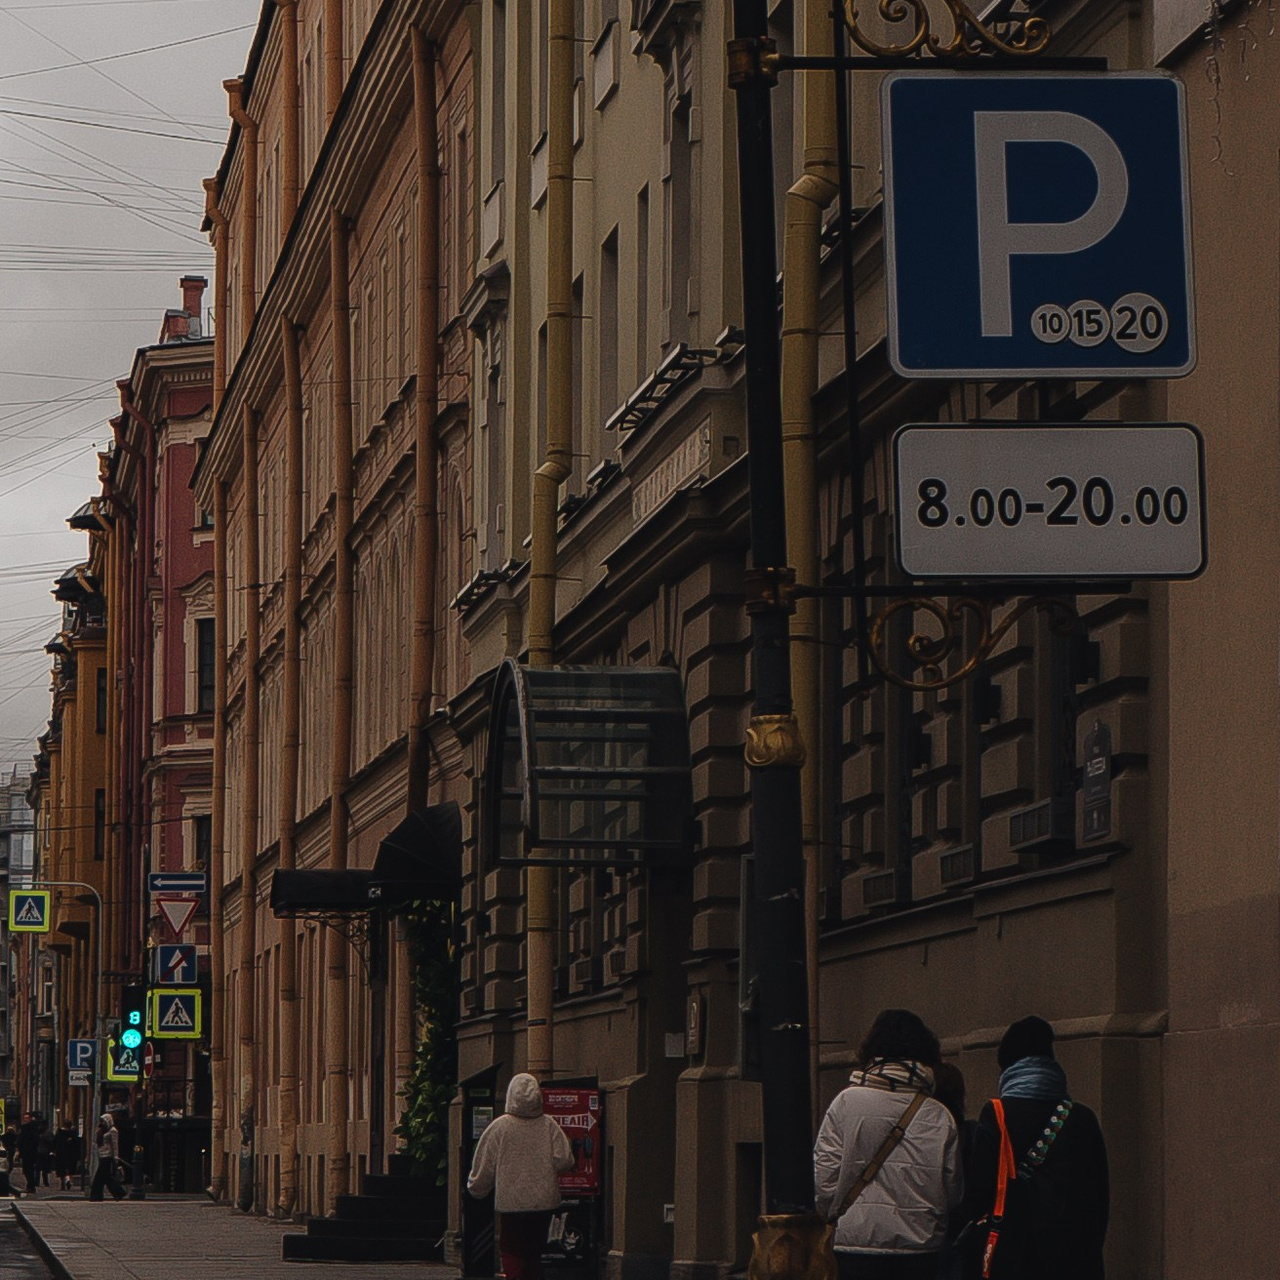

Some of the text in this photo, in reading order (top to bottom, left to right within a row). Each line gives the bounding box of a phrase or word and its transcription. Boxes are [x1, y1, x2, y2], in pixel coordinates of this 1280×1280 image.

[973, 111, 1128, 337] P
[1038, 306, 1162, 340] 10 15 20
[917, 477, 1188, 527] 8.00-20.00
[76, 1043, 92, 1066] P
